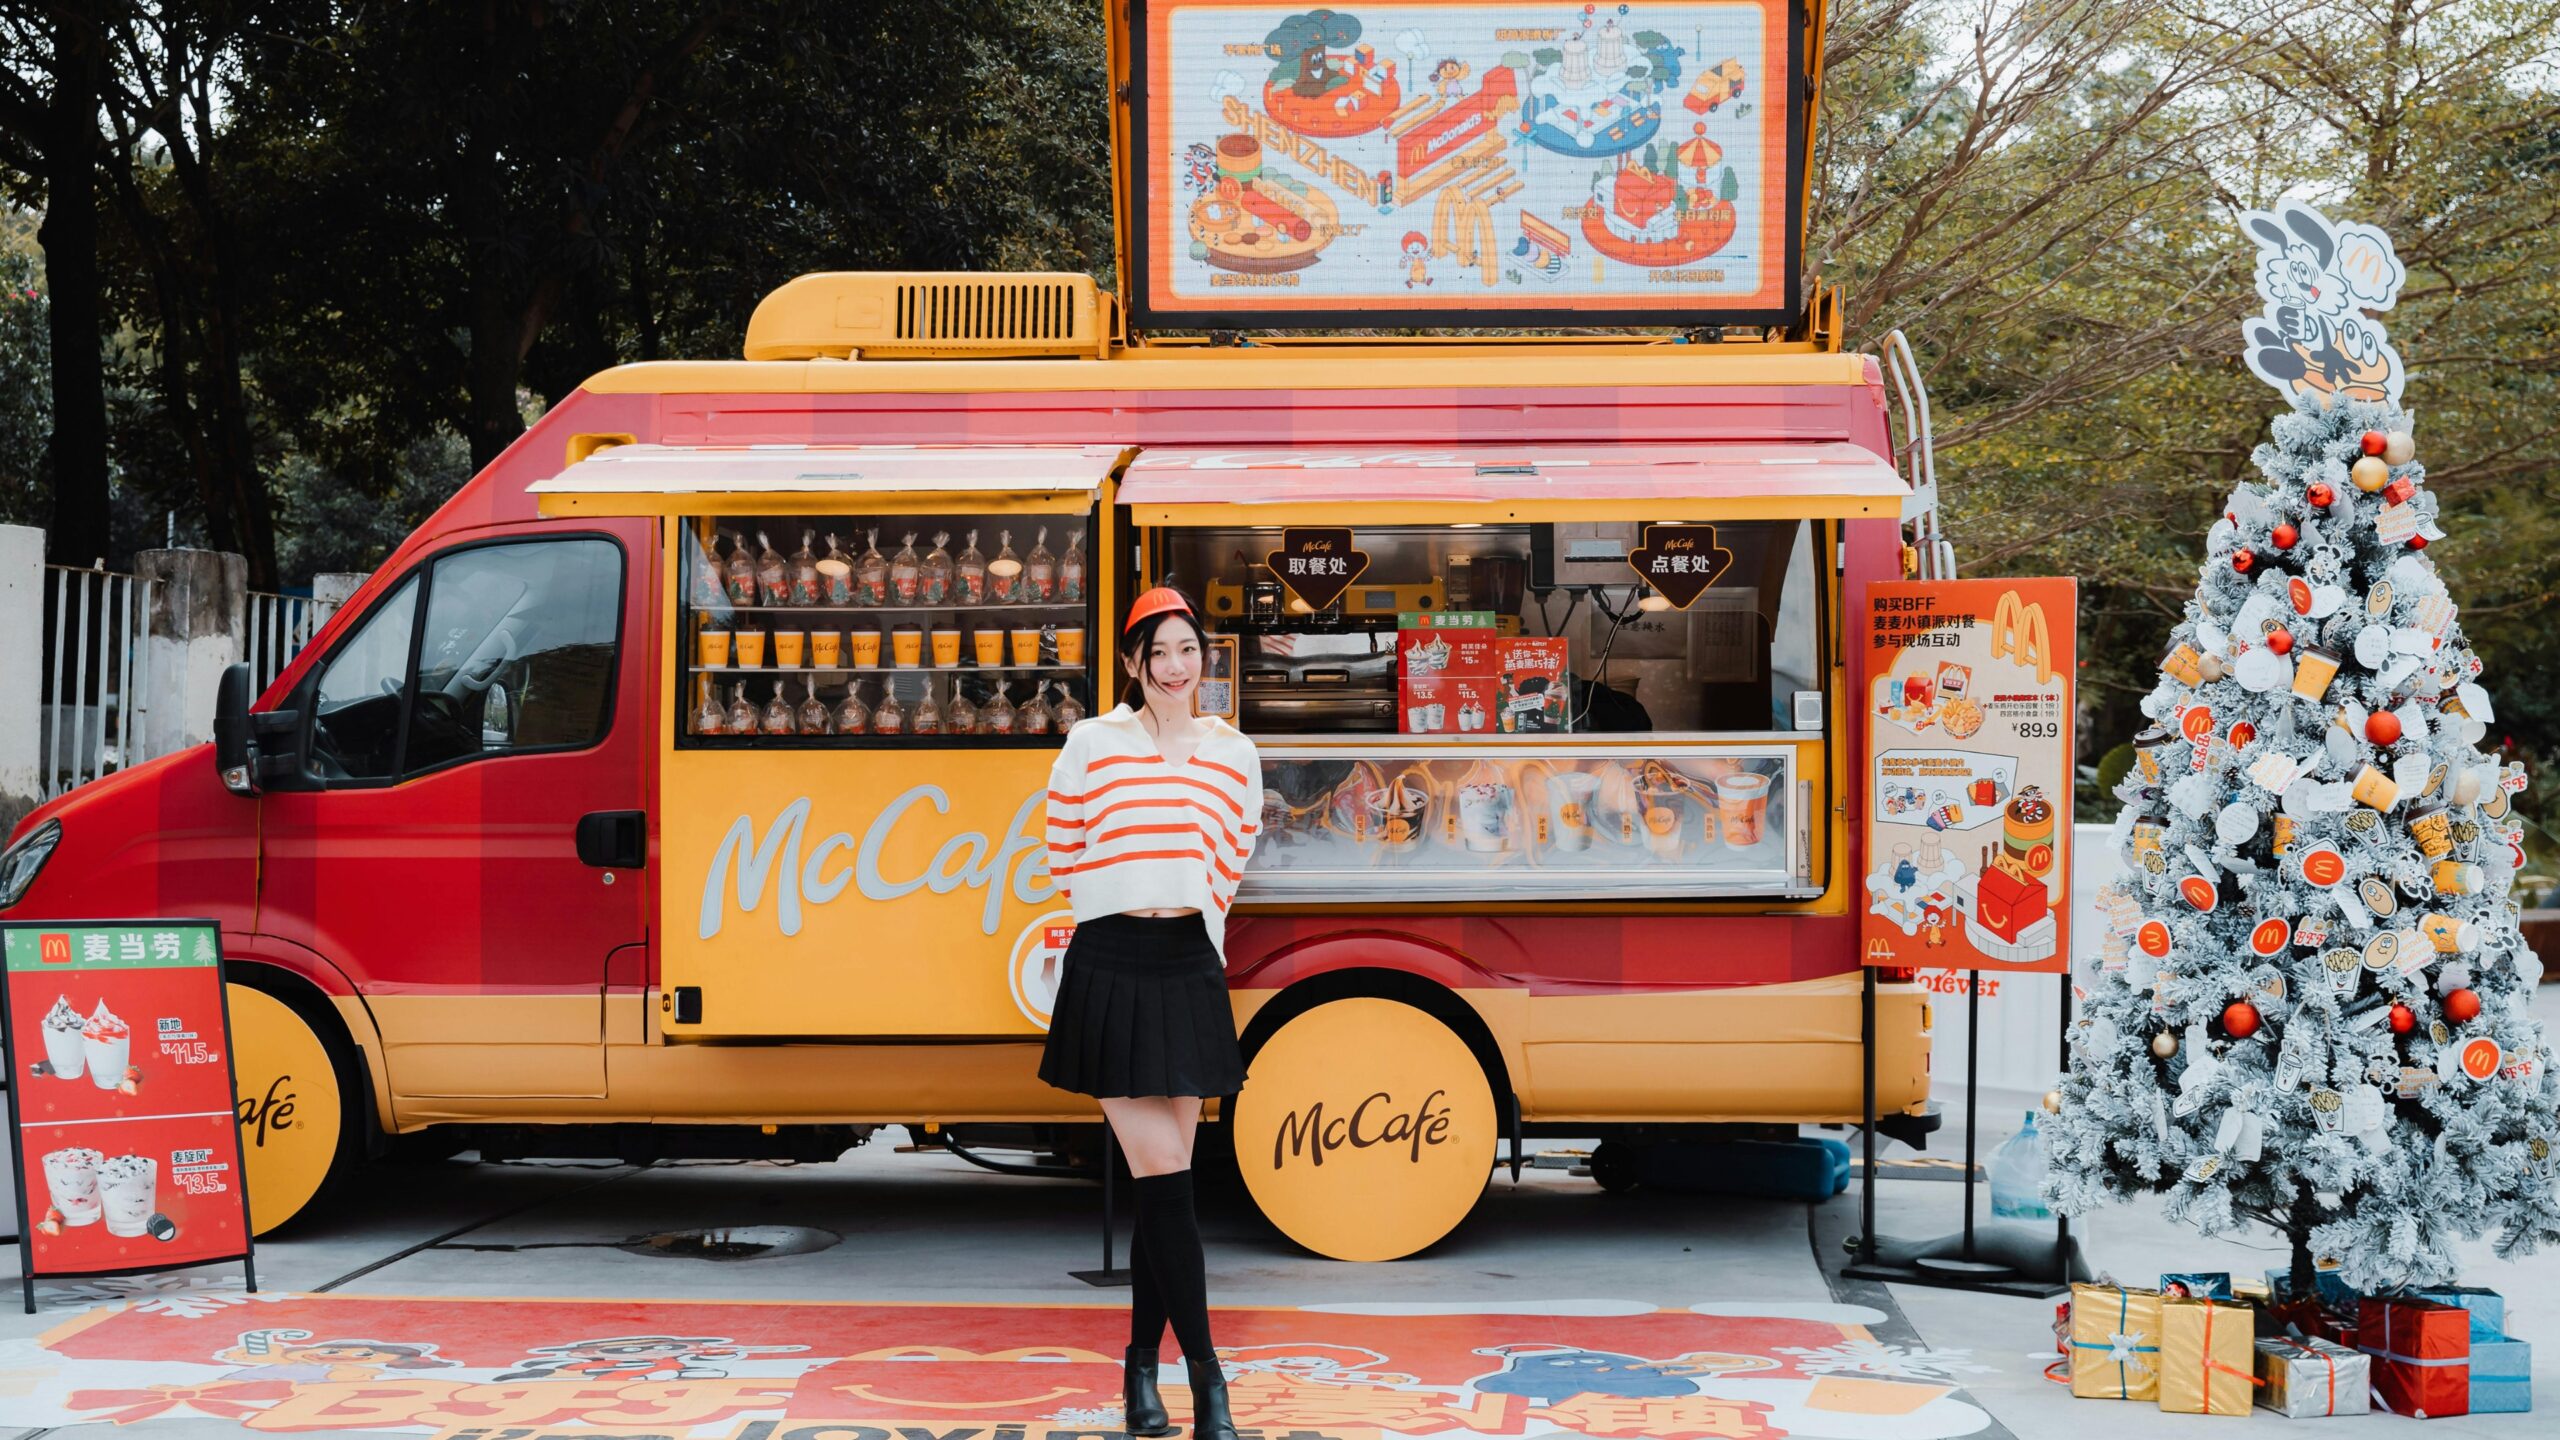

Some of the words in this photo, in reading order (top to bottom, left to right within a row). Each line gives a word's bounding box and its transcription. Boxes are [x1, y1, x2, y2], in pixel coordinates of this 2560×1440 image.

[1427, 113, 1482, 154] McDonald's
[1222, 95, 1378, 207] SHENZHEN
[1303, 540, 1333, 553] McCafé
[1665, 538, 1695, 551] McCafé
[1288, 557, 1347, 575] 取餐处
[1651, 555, 1710, 573] 点餐处
[1873, 597, 1936, 612] 购买BFF
[1435, 614, 1474, 626] 麦当劳
[1873, 614, 1976, 630] 麦麦小镇派对餐
[1873, 633, 1960, 648] 参与现场互动
[2012, 722, 2058, 738] ¥89.9
[2296, 930, 2328, 946] BFF
[83, 932, 181, 962] 麦当劳
[159, 1018, 182, 1031] 新地
[160, 1042, 208, 1065] ¥11.5
[1274, 1089, 1451, 1170] McCafé
[173, 1150, 207, 1164] 麦旋风
[173, 1172, 219, 1195] ¥13.5
